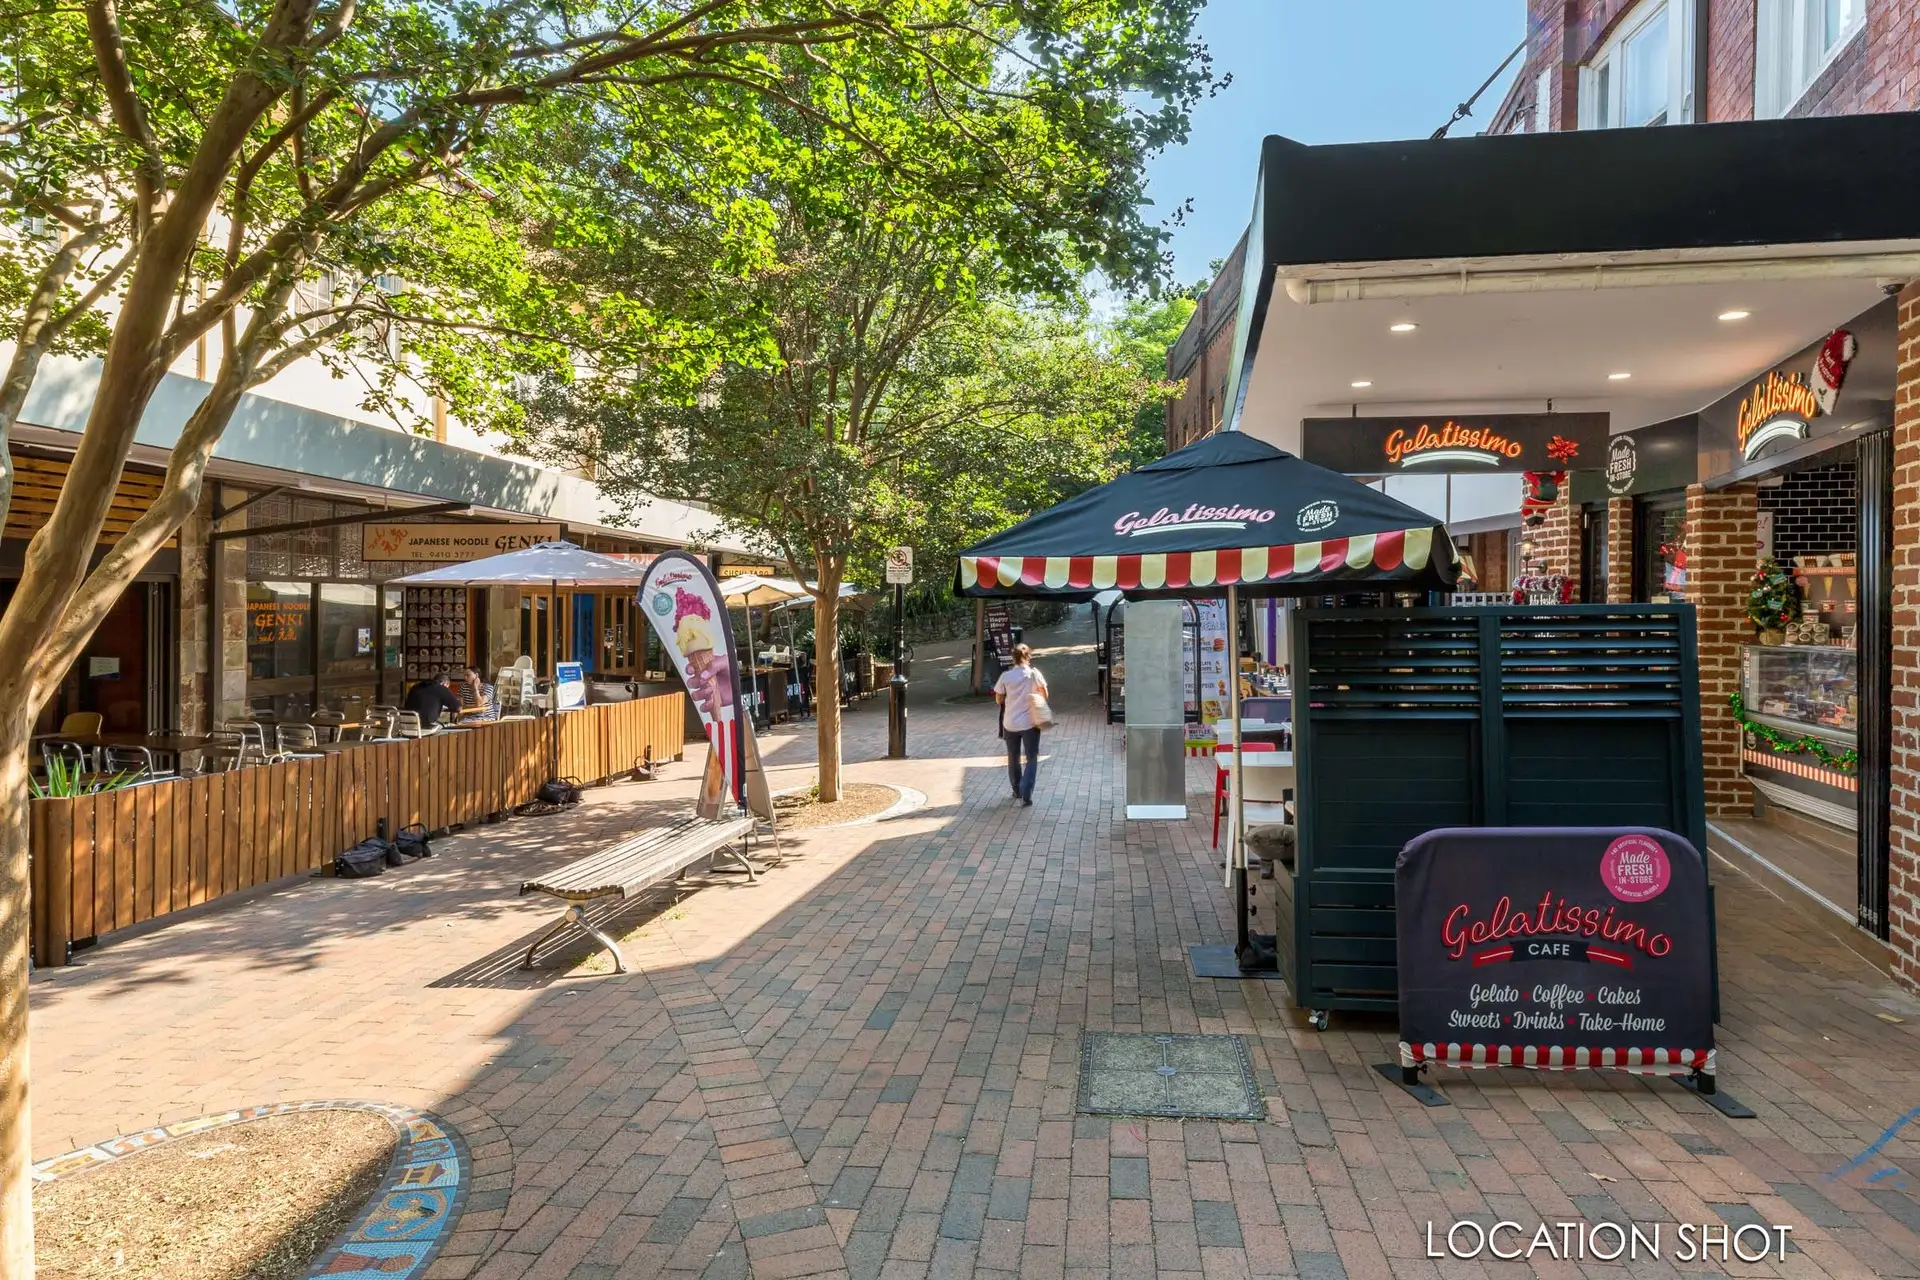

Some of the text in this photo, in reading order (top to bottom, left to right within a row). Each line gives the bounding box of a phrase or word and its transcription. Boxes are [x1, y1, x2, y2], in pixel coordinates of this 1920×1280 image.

[1737, 371, 1817, 453] Gelatissimo
[1384, 421, 1522, 463] Gelatissimo
[1611, 445, 1631, 462] Made
[1609, 458, 1632, 474] FRESH
[1114, 503, 1276, 536] Gelatissimo
[408, 537, 450, 546] JAPANESE
[453, 537, 489, 546] NOODLE
[255, 613, 304, 631] GENKI
[1619, 850, 1651, 865] Made
[1617, 864, 1653, 876] FRESH
[1618, 876, 1654, 885] IN-STORE
[1442, 891, 1672, 960] Gelatissimo
[1527, 943, 1570, 956] CAFE
[1470, 984, 1641, 1009] Gelato Coffee Cakes
[1448, 1010, 1666, 1032] Sweets Drinks Take-Home
